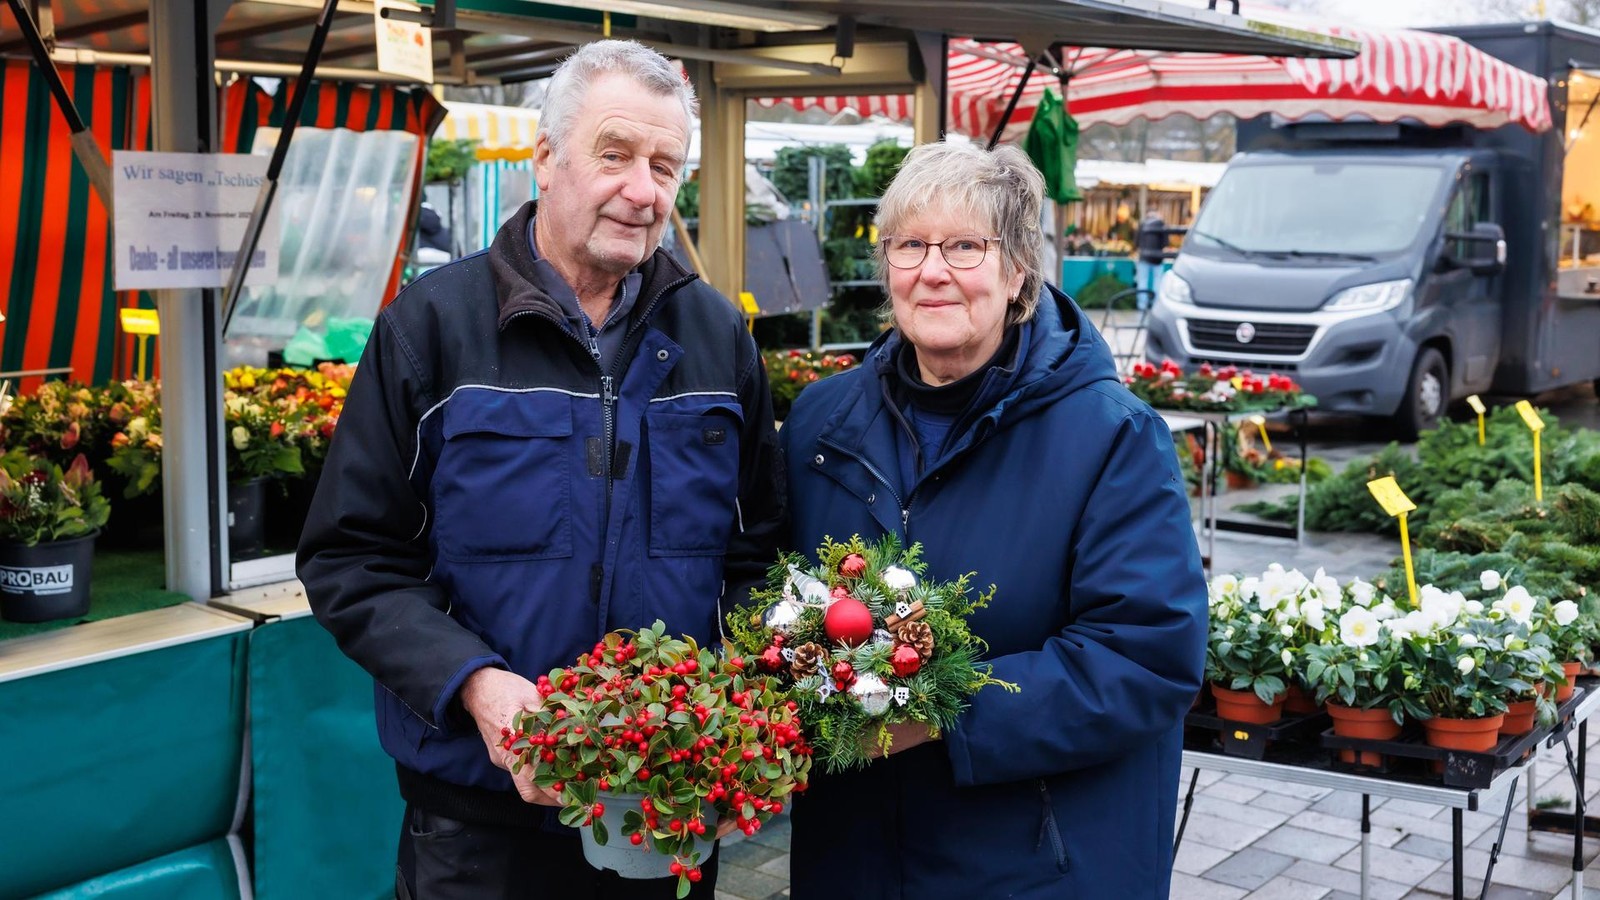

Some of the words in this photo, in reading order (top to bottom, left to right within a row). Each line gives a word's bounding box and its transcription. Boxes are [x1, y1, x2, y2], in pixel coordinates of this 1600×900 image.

[123, 164, 154, 180] Wir
[158, 168, 203, 186] sagen
[148, 210, 161, 218] Am
[129, 245, 158, 271] Danke
[180, 250, 215, 270] unseren
